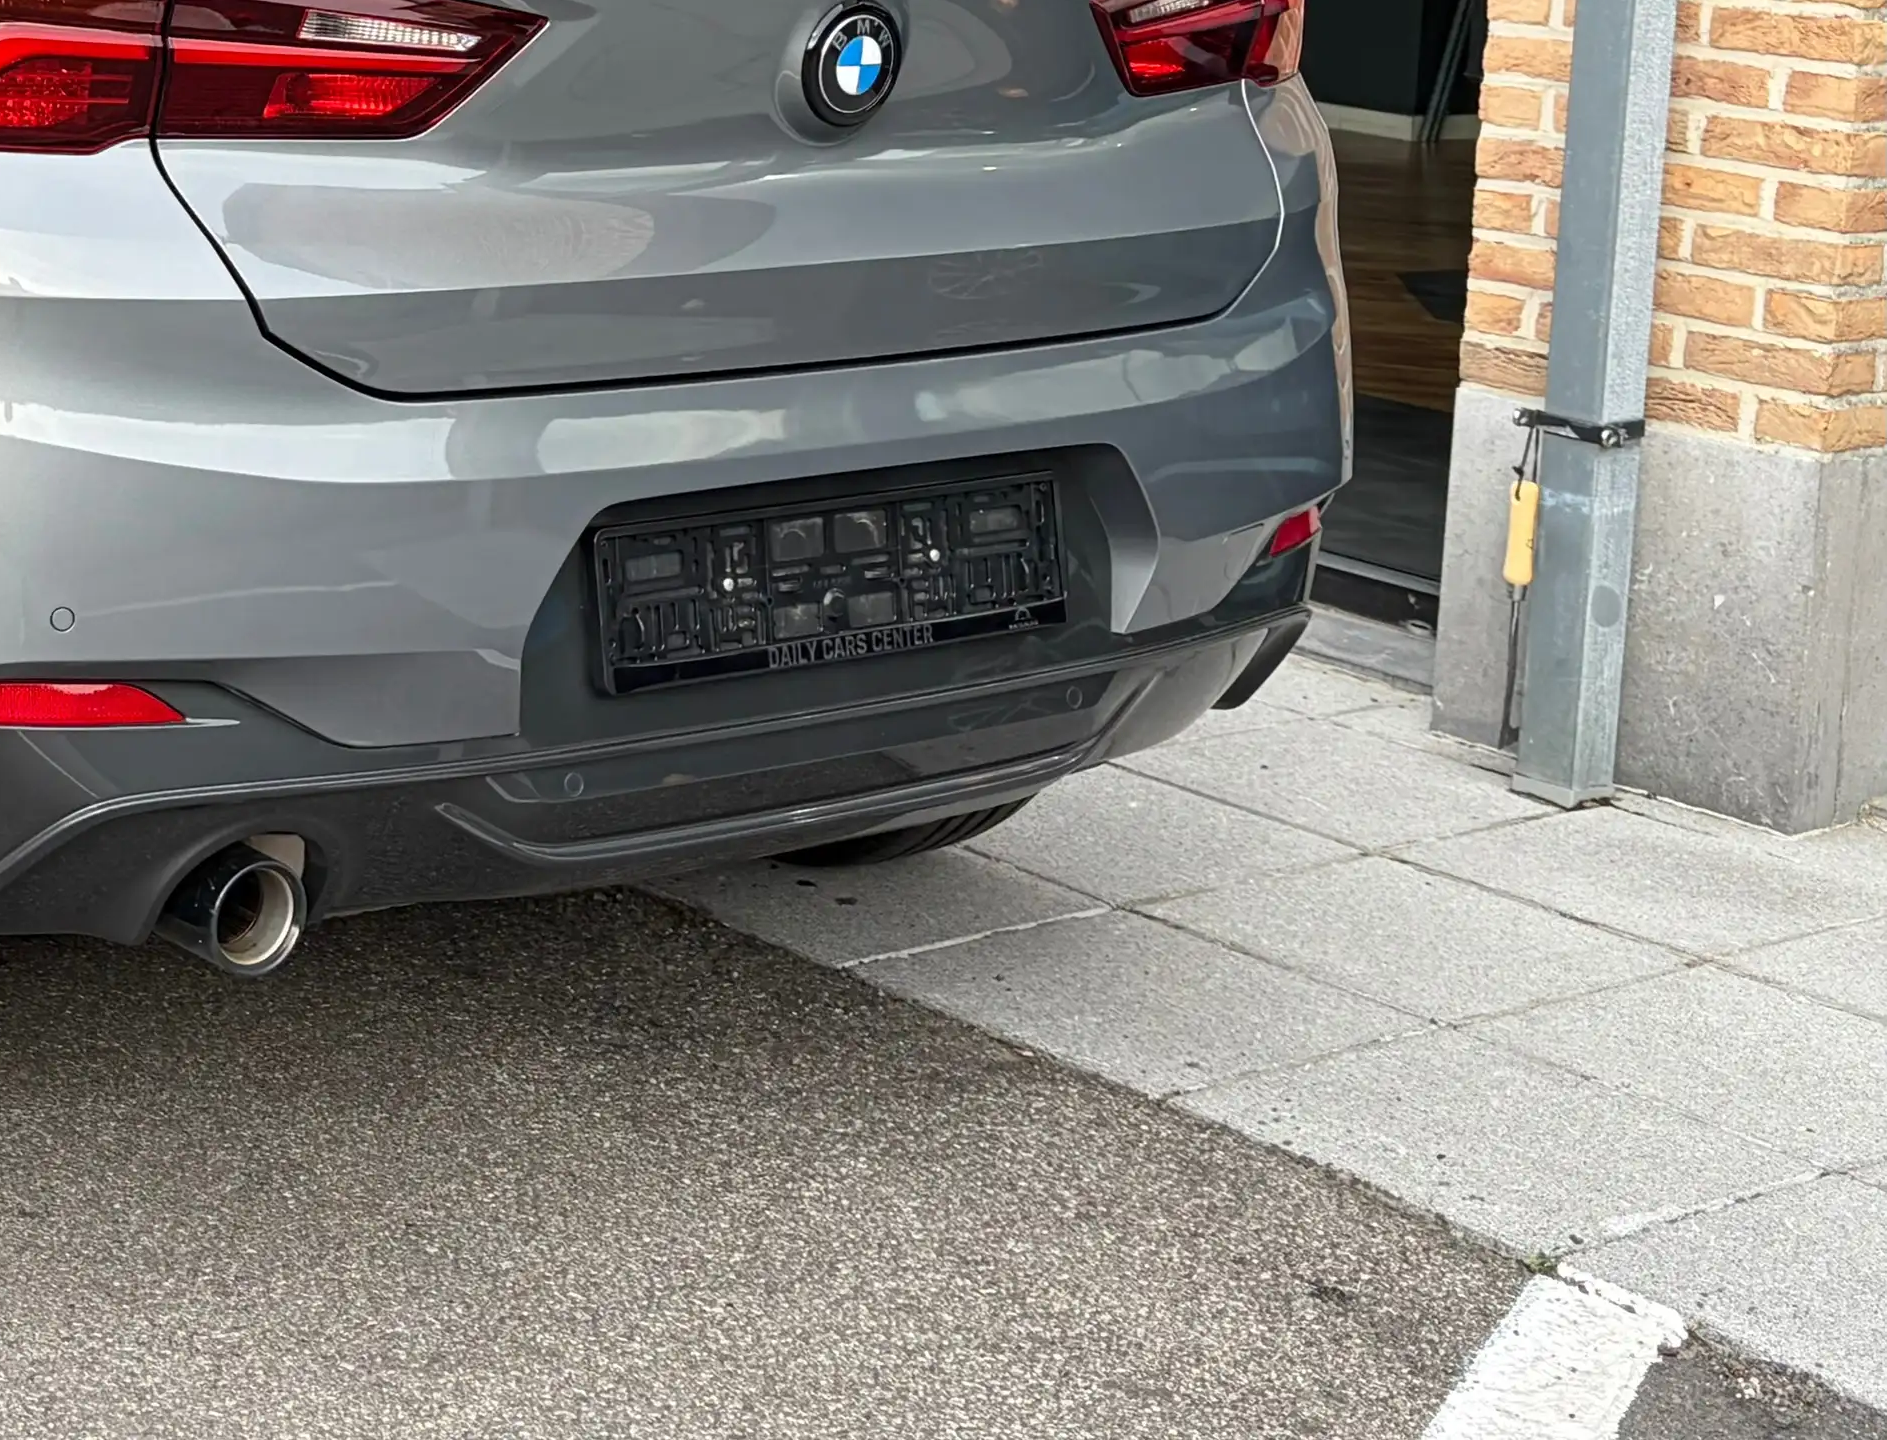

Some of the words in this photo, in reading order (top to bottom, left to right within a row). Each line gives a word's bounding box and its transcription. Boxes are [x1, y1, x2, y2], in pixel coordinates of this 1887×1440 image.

[832, 19, 891, 51] BMW
[768, 639, 818, 669] DAILY
[822, 633, 868, 660] CARS
[872, 624, 934, 650] CENTER
